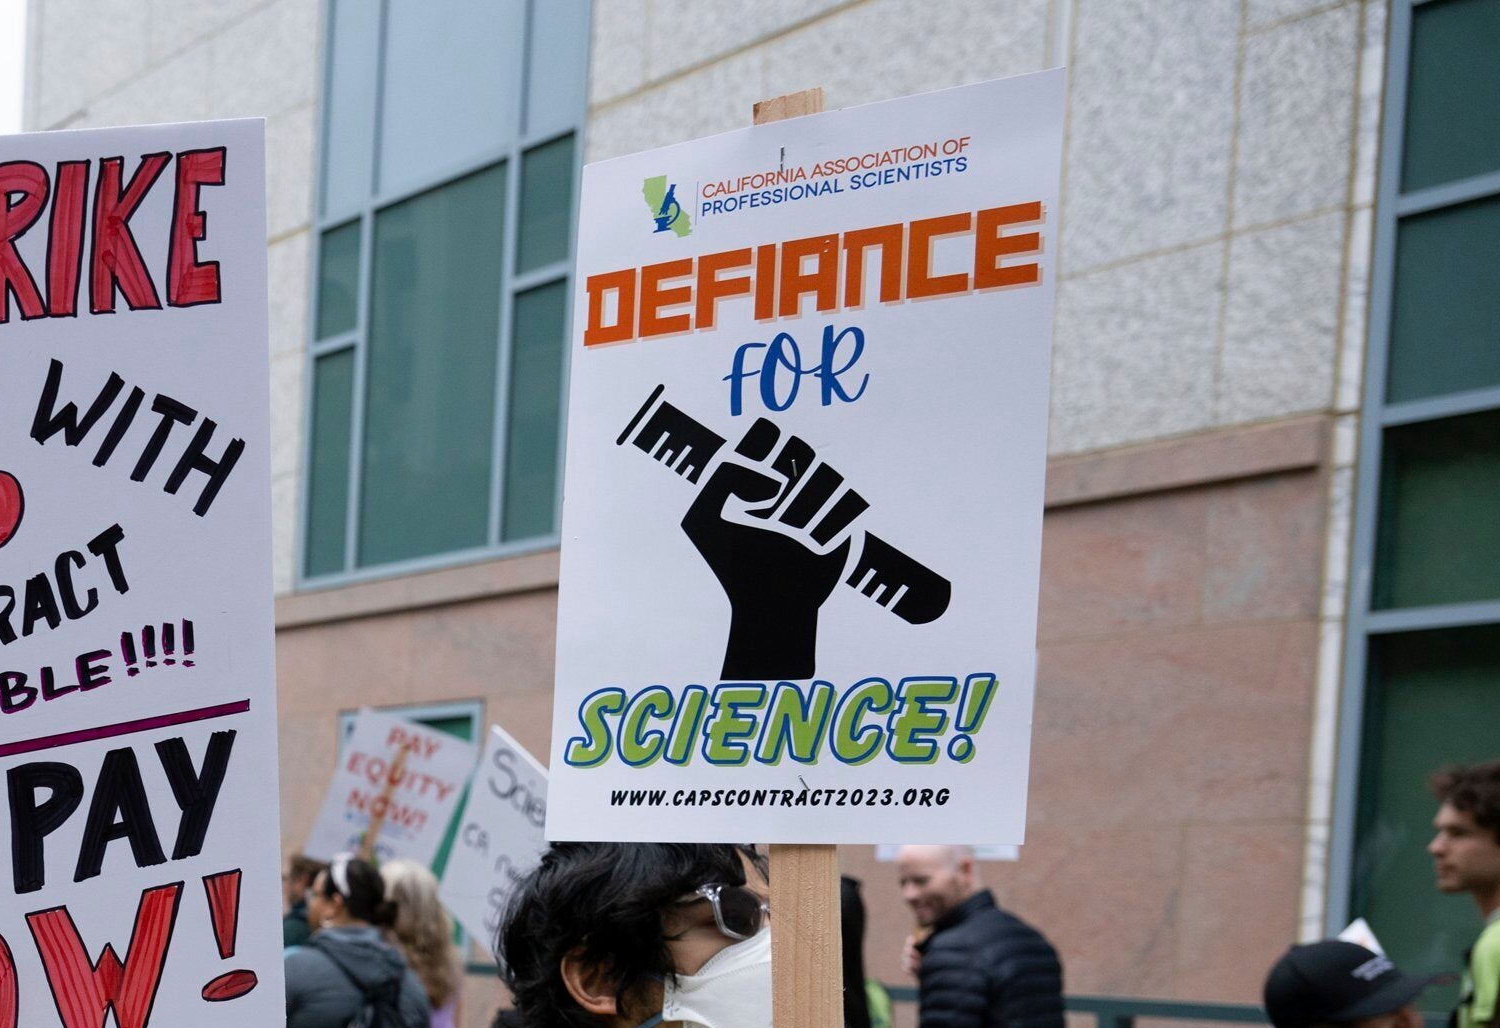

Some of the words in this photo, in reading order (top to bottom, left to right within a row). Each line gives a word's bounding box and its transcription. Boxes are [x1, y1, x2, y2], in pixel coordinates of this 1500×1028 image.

[701, 178, 844, 217] PROFESSIONAL
[850, 156, 968, 190] SCIENTISTS
[702, 166, 808, 199] CALIFORNIA
[810, 142, 938, 179] ASSOCIATION
[942, 136, 971, 154] OF
[584, 201, 1046, 348] DEFIANCE
[722, 324, 870, 417] FOR
[30, 358, 246, 518] WITH
[386, 726, 442, 760] PAY
[564, 672, 999, 768] SCIENCE!
[346, 751, 455, 803] EQUITY
[610, 787, 951, 809] WWW.CAPSCONTRACT2023.ORG
[6, 729, 237, 894] PAY
[346, 789, 428, 832] NOW!
